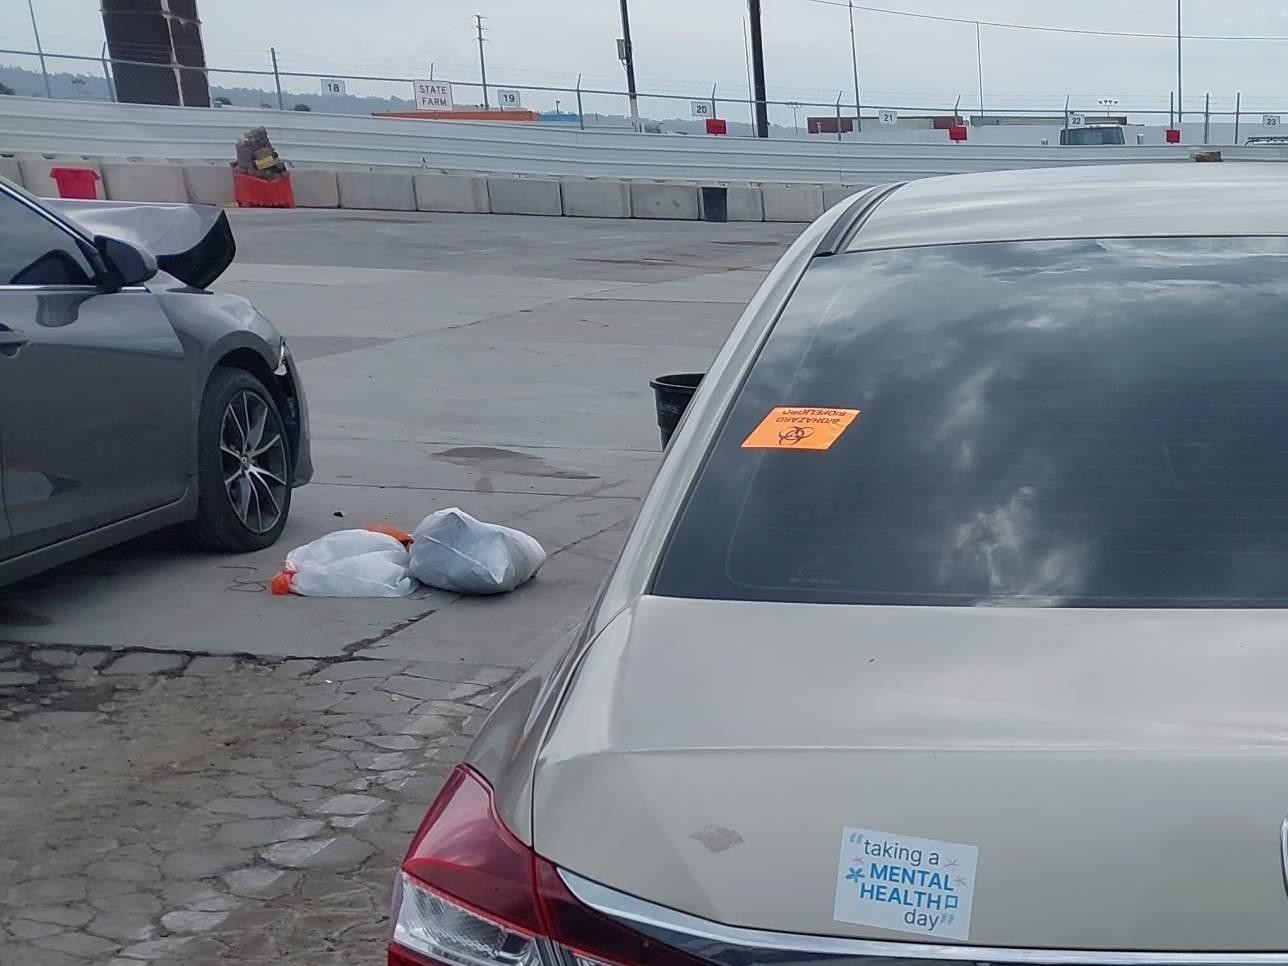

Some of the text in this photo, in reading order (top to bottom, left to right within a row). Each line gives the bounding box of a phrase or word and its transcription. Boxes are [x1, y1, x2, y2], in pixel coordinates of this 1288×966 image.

[327, 83, 340, 93] 18
[419, 85, 447, 95] STATE
[421, 97, 447, 107] FARM
[503, 94, 515, 103] 19
[696, 105, 707, 114] 20
[883, 114, 893, 122] 21
[1071, 117, 1081, 125] 22
[1266, 117, 1276, 126] 23
[776, 416, 841, 425] BIOHAZARD
[928, 851, 940, 866] a
[870, 863, 954, 891] MENTAL
[860, 882, 942, 910] HEALTH
